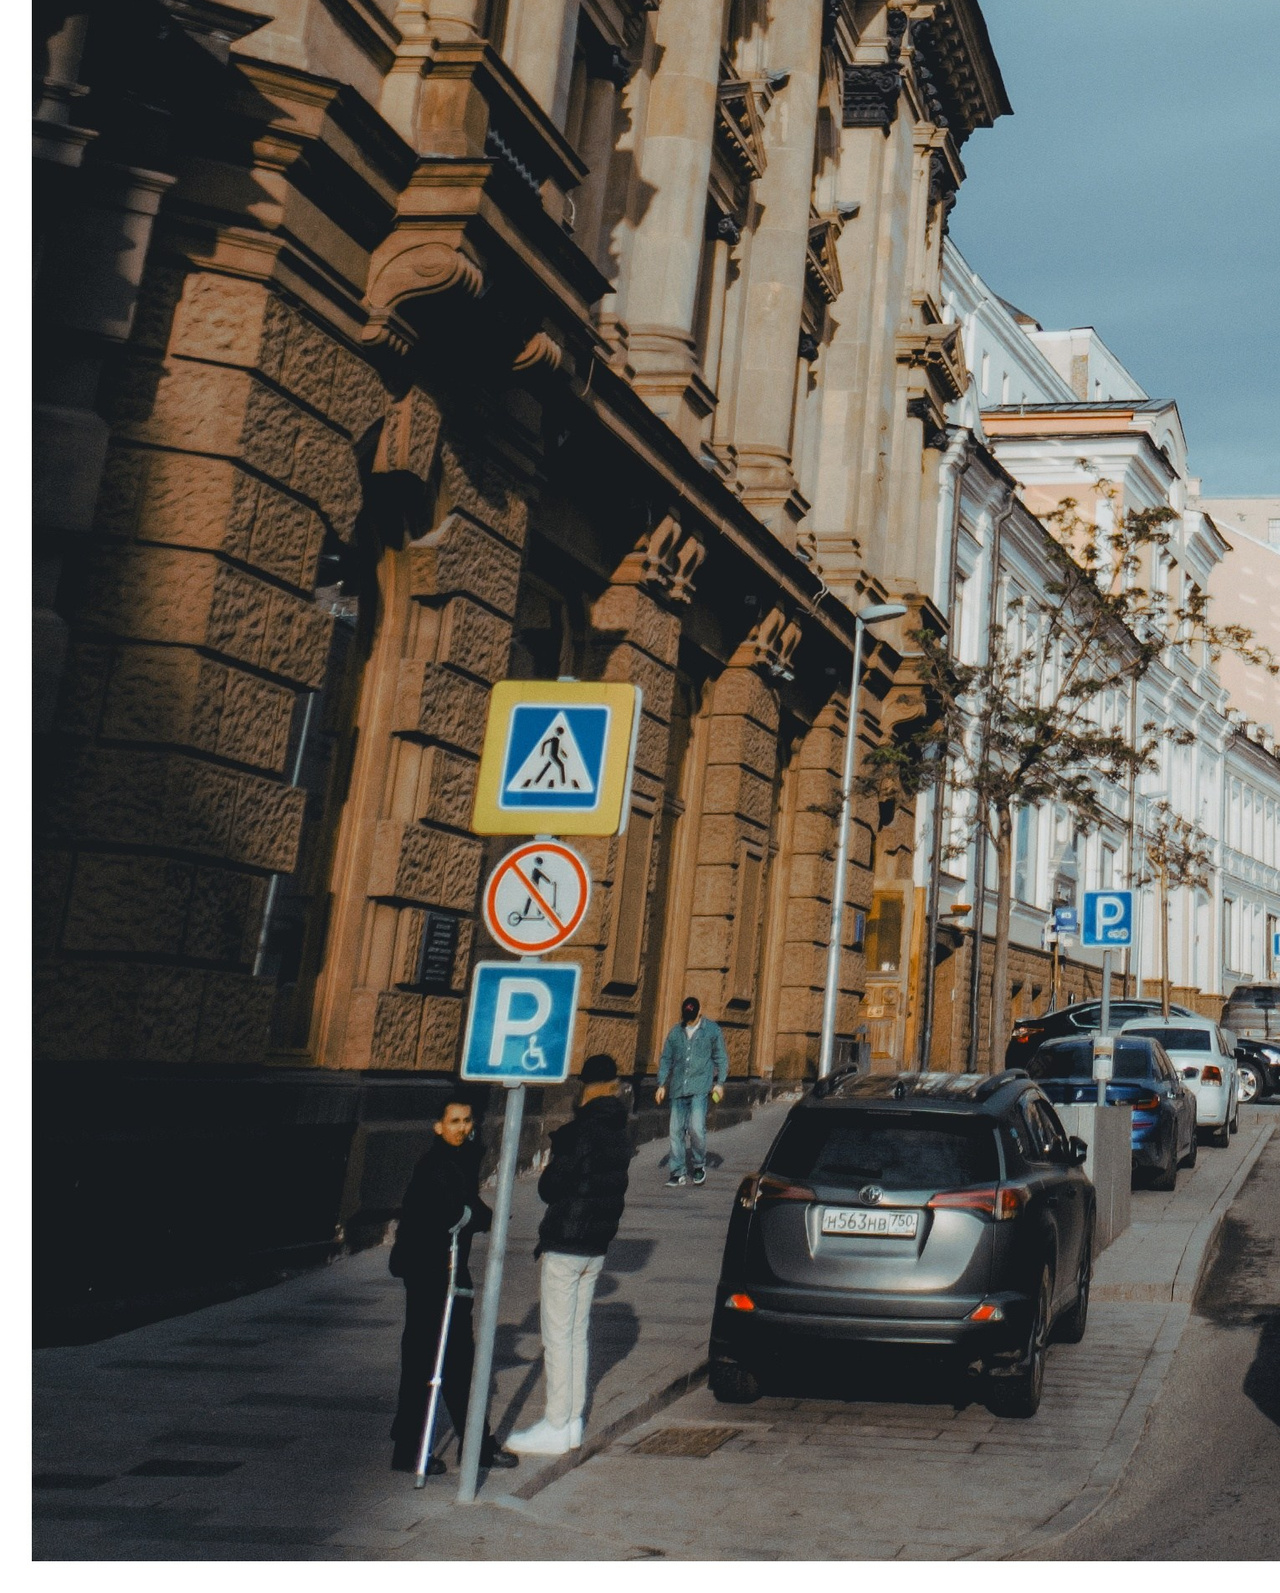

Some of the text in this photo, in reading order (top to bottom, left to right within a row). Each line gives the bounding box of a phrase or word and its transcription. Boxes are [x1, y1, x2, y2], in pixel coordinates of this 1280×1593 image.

[1096, 896, 1124, 941] P
[488, 977, 552, 1067] P
[890, 1214, 913, 1227] 750
